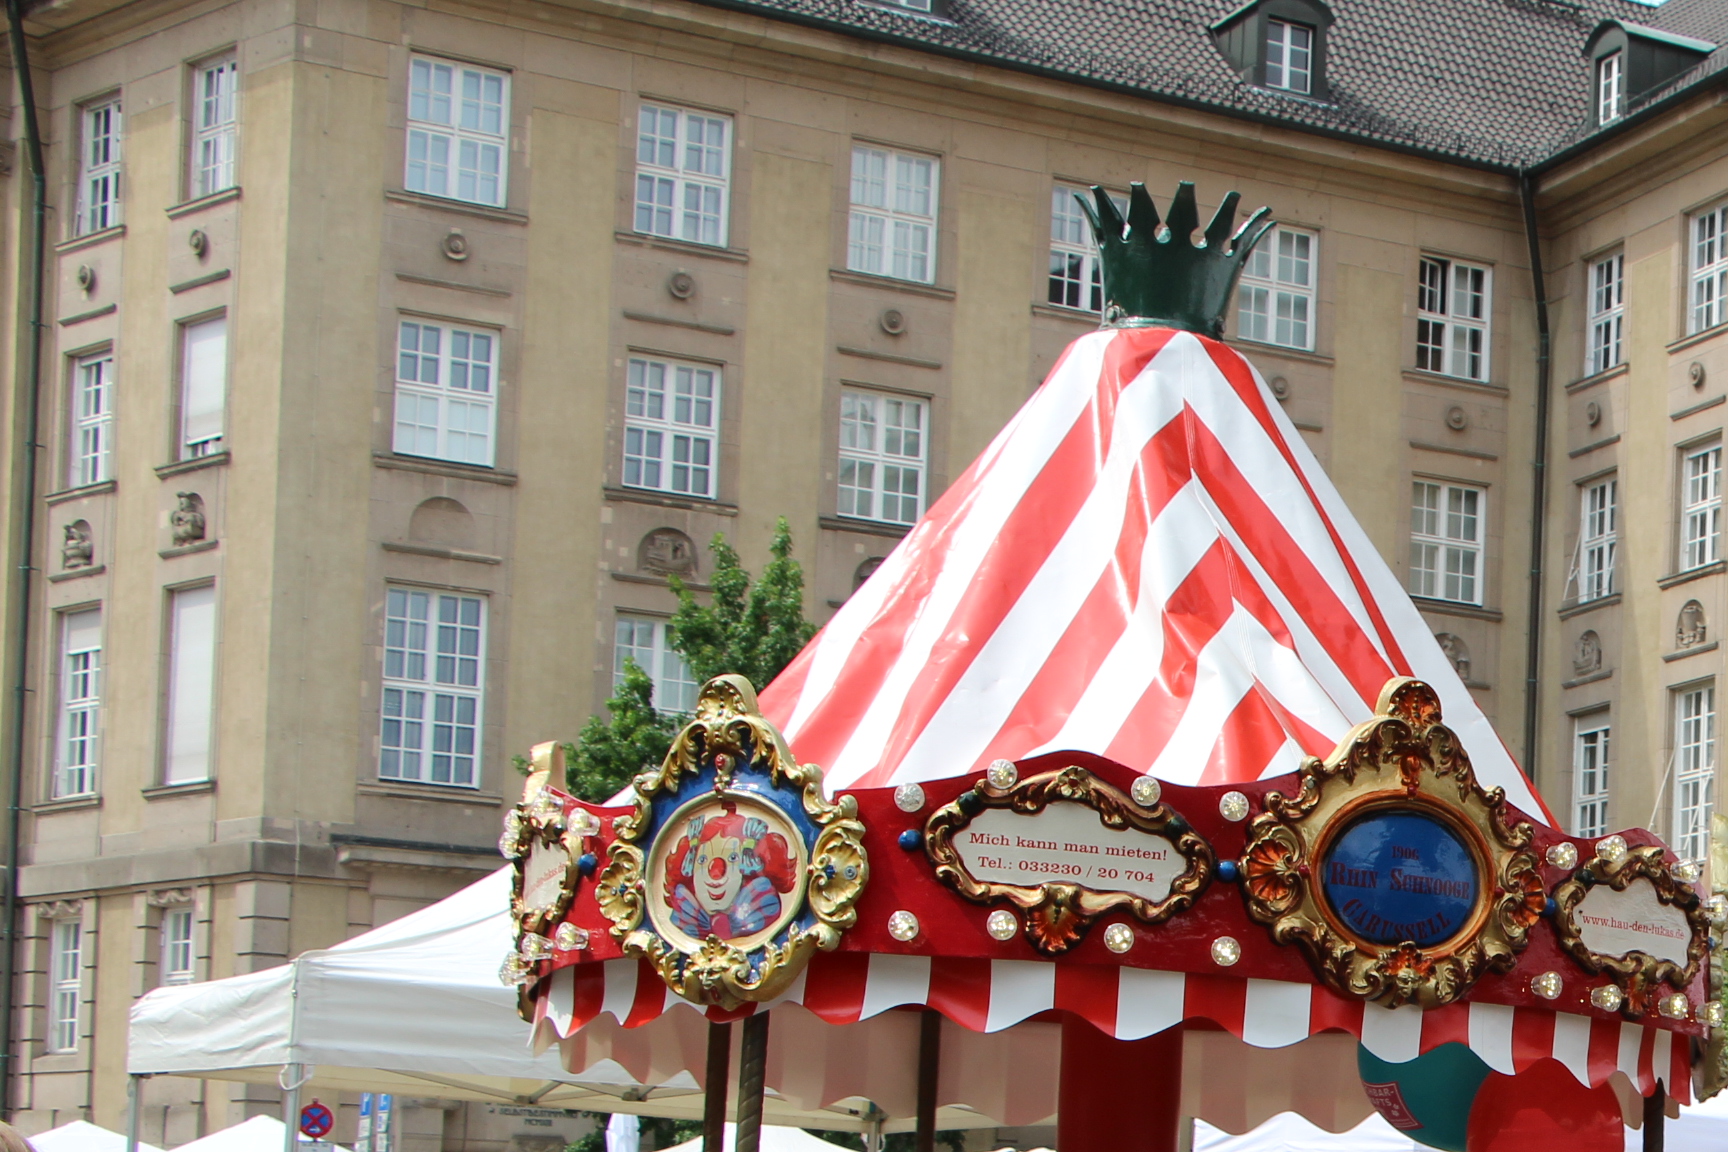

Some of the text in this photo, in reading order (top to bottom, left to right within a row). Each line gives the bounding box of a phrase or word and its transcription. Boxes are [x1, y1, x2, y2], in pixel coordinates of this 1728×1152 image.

[969, 833, 1167, 861] Mich kann man mieten!
[978, 856, 1012, 870] Tel.:
[1018, 860, 1082, 876] 033230
[1098, 868, 1118, 879] 20
[1124, 871, 1155, 883] 704
[1582, 914, 1685, 940] www.hau-den-lukas.de
